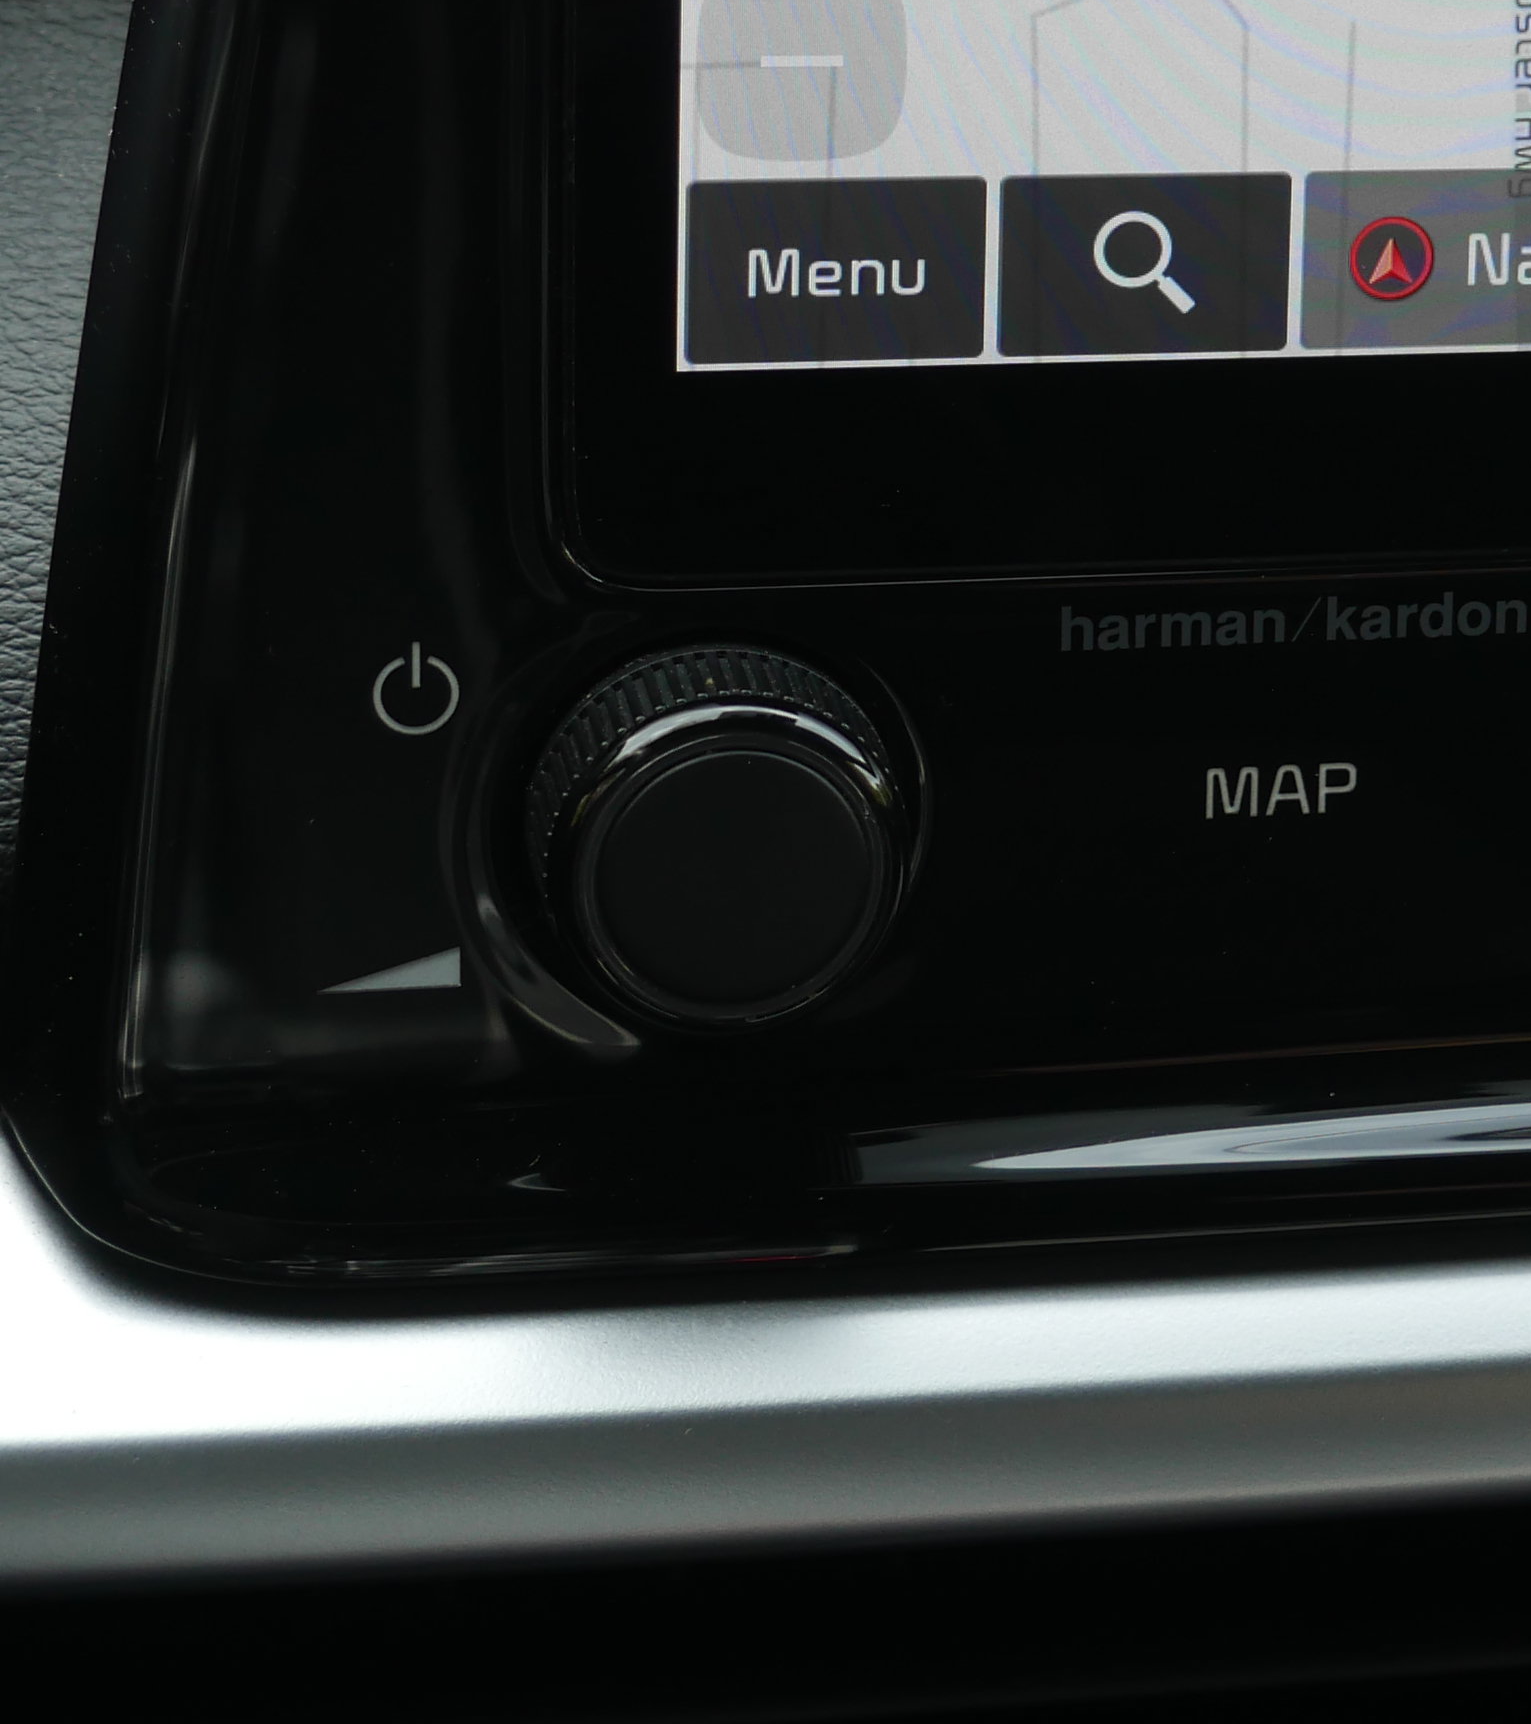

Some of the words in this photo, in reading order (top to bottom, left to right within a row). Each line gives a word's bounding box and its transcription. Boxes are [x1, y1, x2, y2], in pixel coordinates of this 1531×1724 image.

[746, 246, 926, 298] Menu
[1059, 591, 1528, 651] harman/kardon
[1204, 761, 1358, 820] MAP
